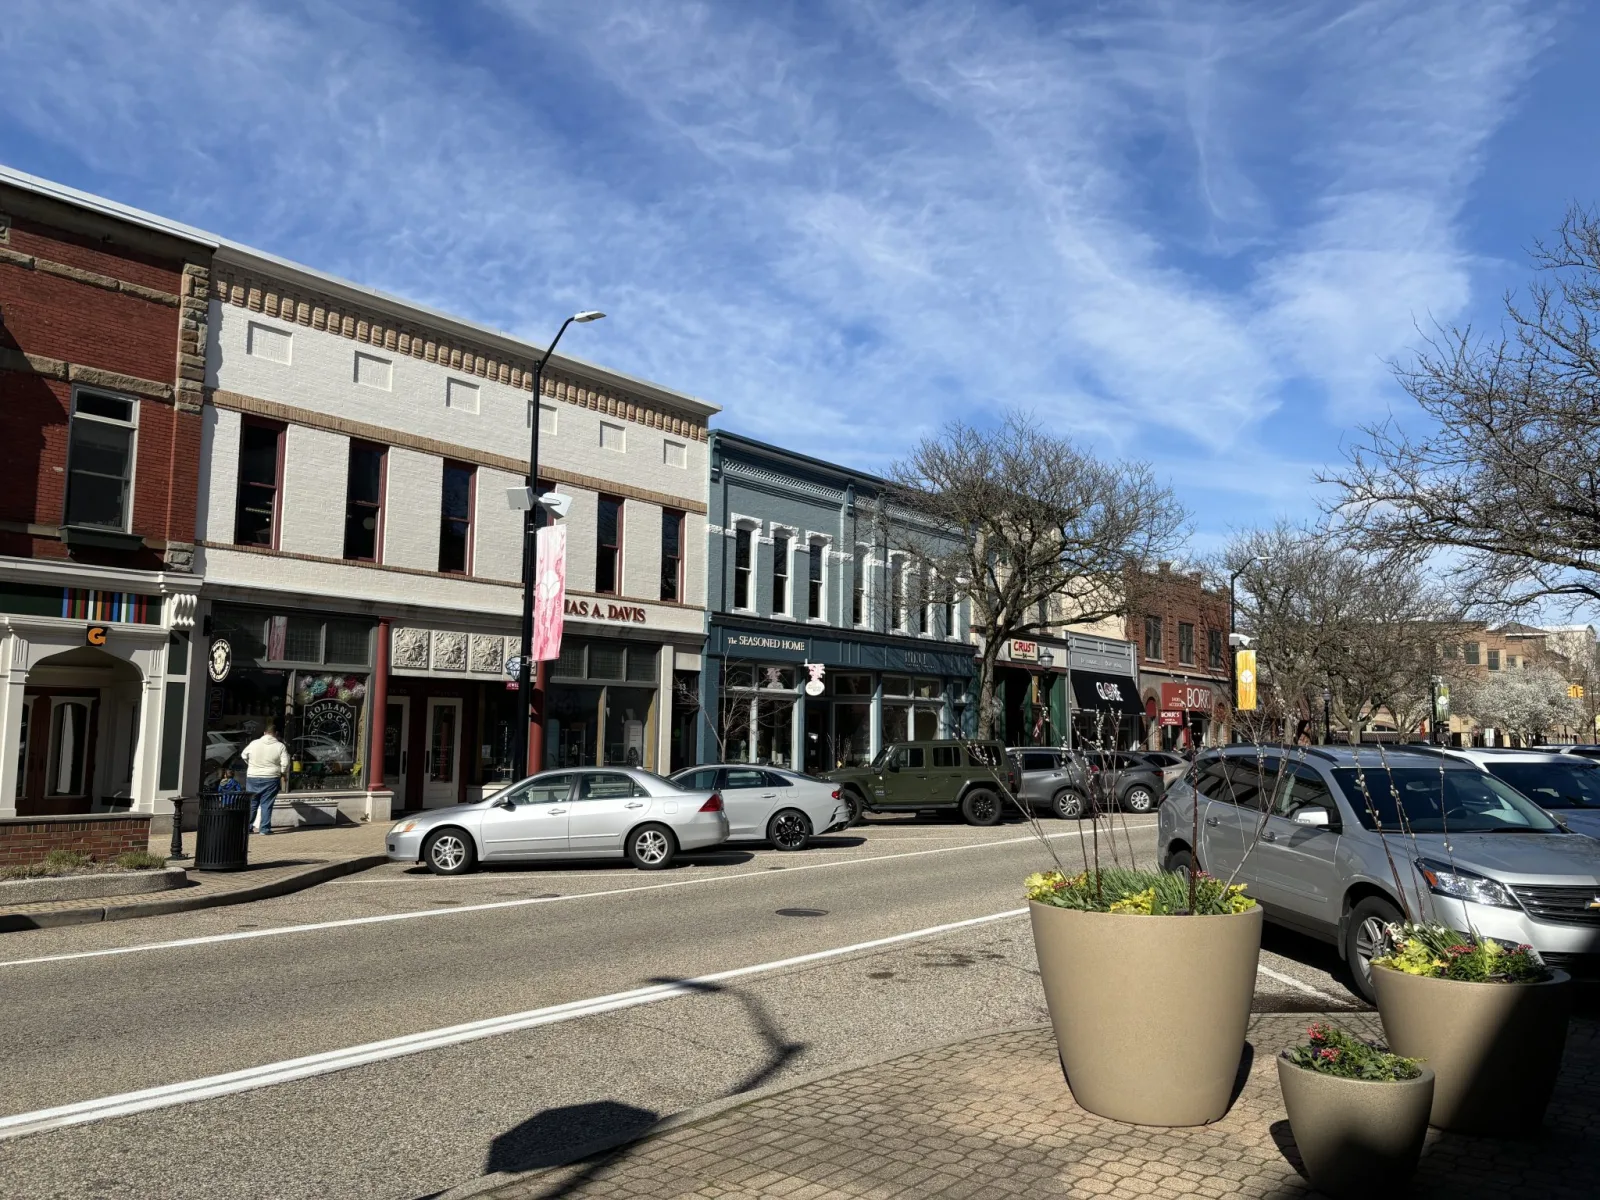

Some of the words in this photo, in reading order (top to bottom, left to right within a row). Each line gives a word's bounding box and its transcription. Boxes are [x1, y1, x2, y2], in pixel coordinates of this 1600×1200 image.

[591, 603, 605, 618] A.
[608, 605, 646, 622] DAVIS
[88, 628, 106, 644] G
[739, 635, 780, 649] SEASONED
[782, 640, 805, 651] HOME
[1013, 641, 1035, 653] CRUST
[307, 703, 352, 719] HOLLAND
